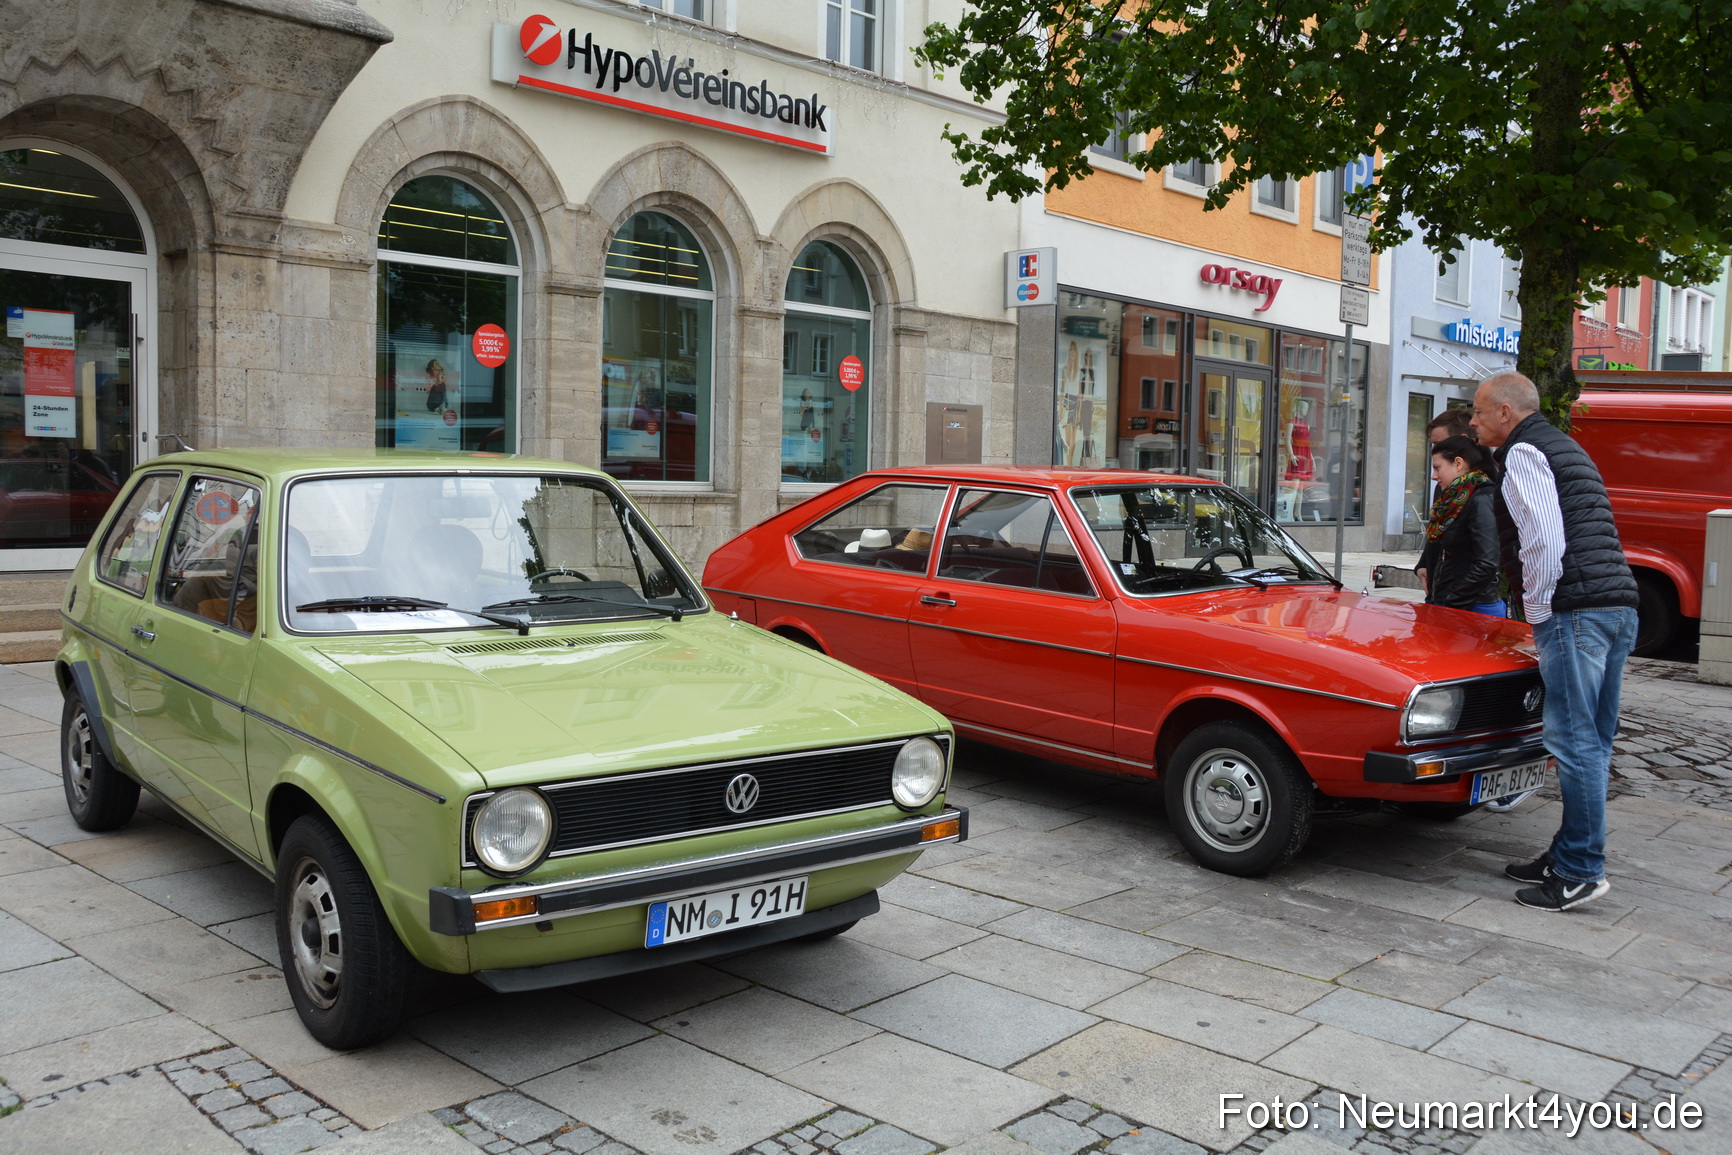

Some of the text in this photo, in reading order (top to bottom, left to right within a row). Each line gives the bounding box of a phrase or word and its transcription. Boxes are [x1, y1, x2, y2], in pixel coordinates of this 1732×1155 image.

[567, 28, 827, 132] HypoVereinsbank
[1352, 152, 1367, 194] P
[1348, 219, 1357, 229] nur
[1346, 242, 1368, 256] werktags
[1343, 265, 1349, 276] Sa
[1200, 264, 1283, 312] orsay
[32, 404, 69, 412] 24-Stunden
[1480, 763, 1546, 799] PAF BI 75H
[666, 899, 706, 938] NM
[750, 881, 806, 920] 91H
[652, 928, 660, 939] D
